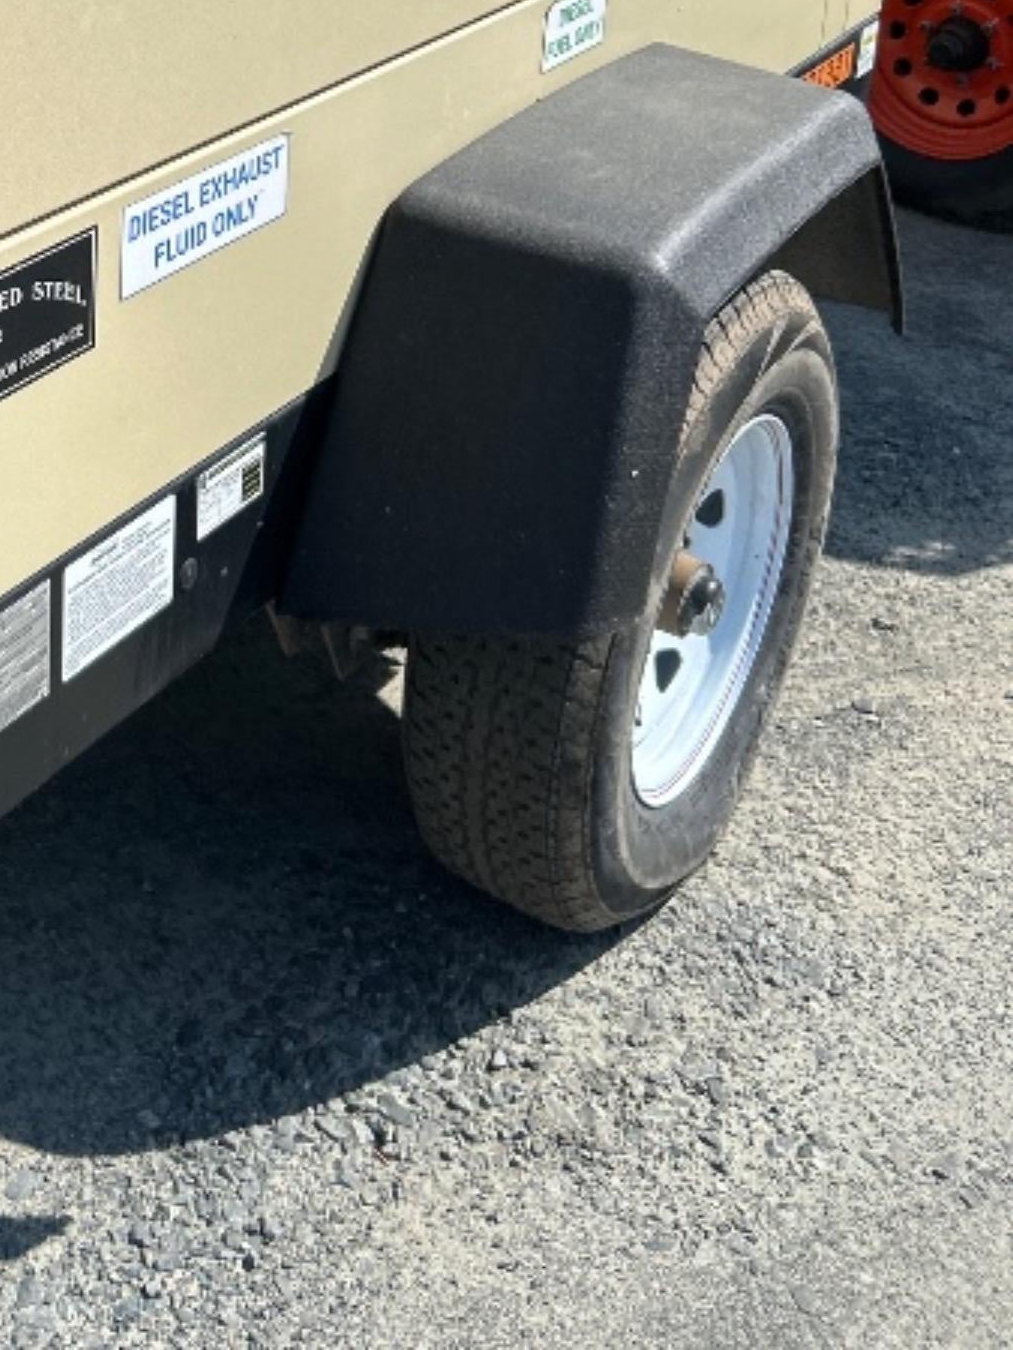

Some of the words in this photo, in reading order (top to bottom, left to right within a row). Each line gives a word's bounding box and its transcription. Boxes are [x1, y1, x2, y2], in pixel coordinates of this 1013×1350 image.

[128, 191, 195, 243] DIESEL
[199, 144, 285, 208] EXHAUST
[154, 221, 207, 268] FLUID
[212, 194, 259, 238] ONLY
[31, 281, 87, 308] STEEL
